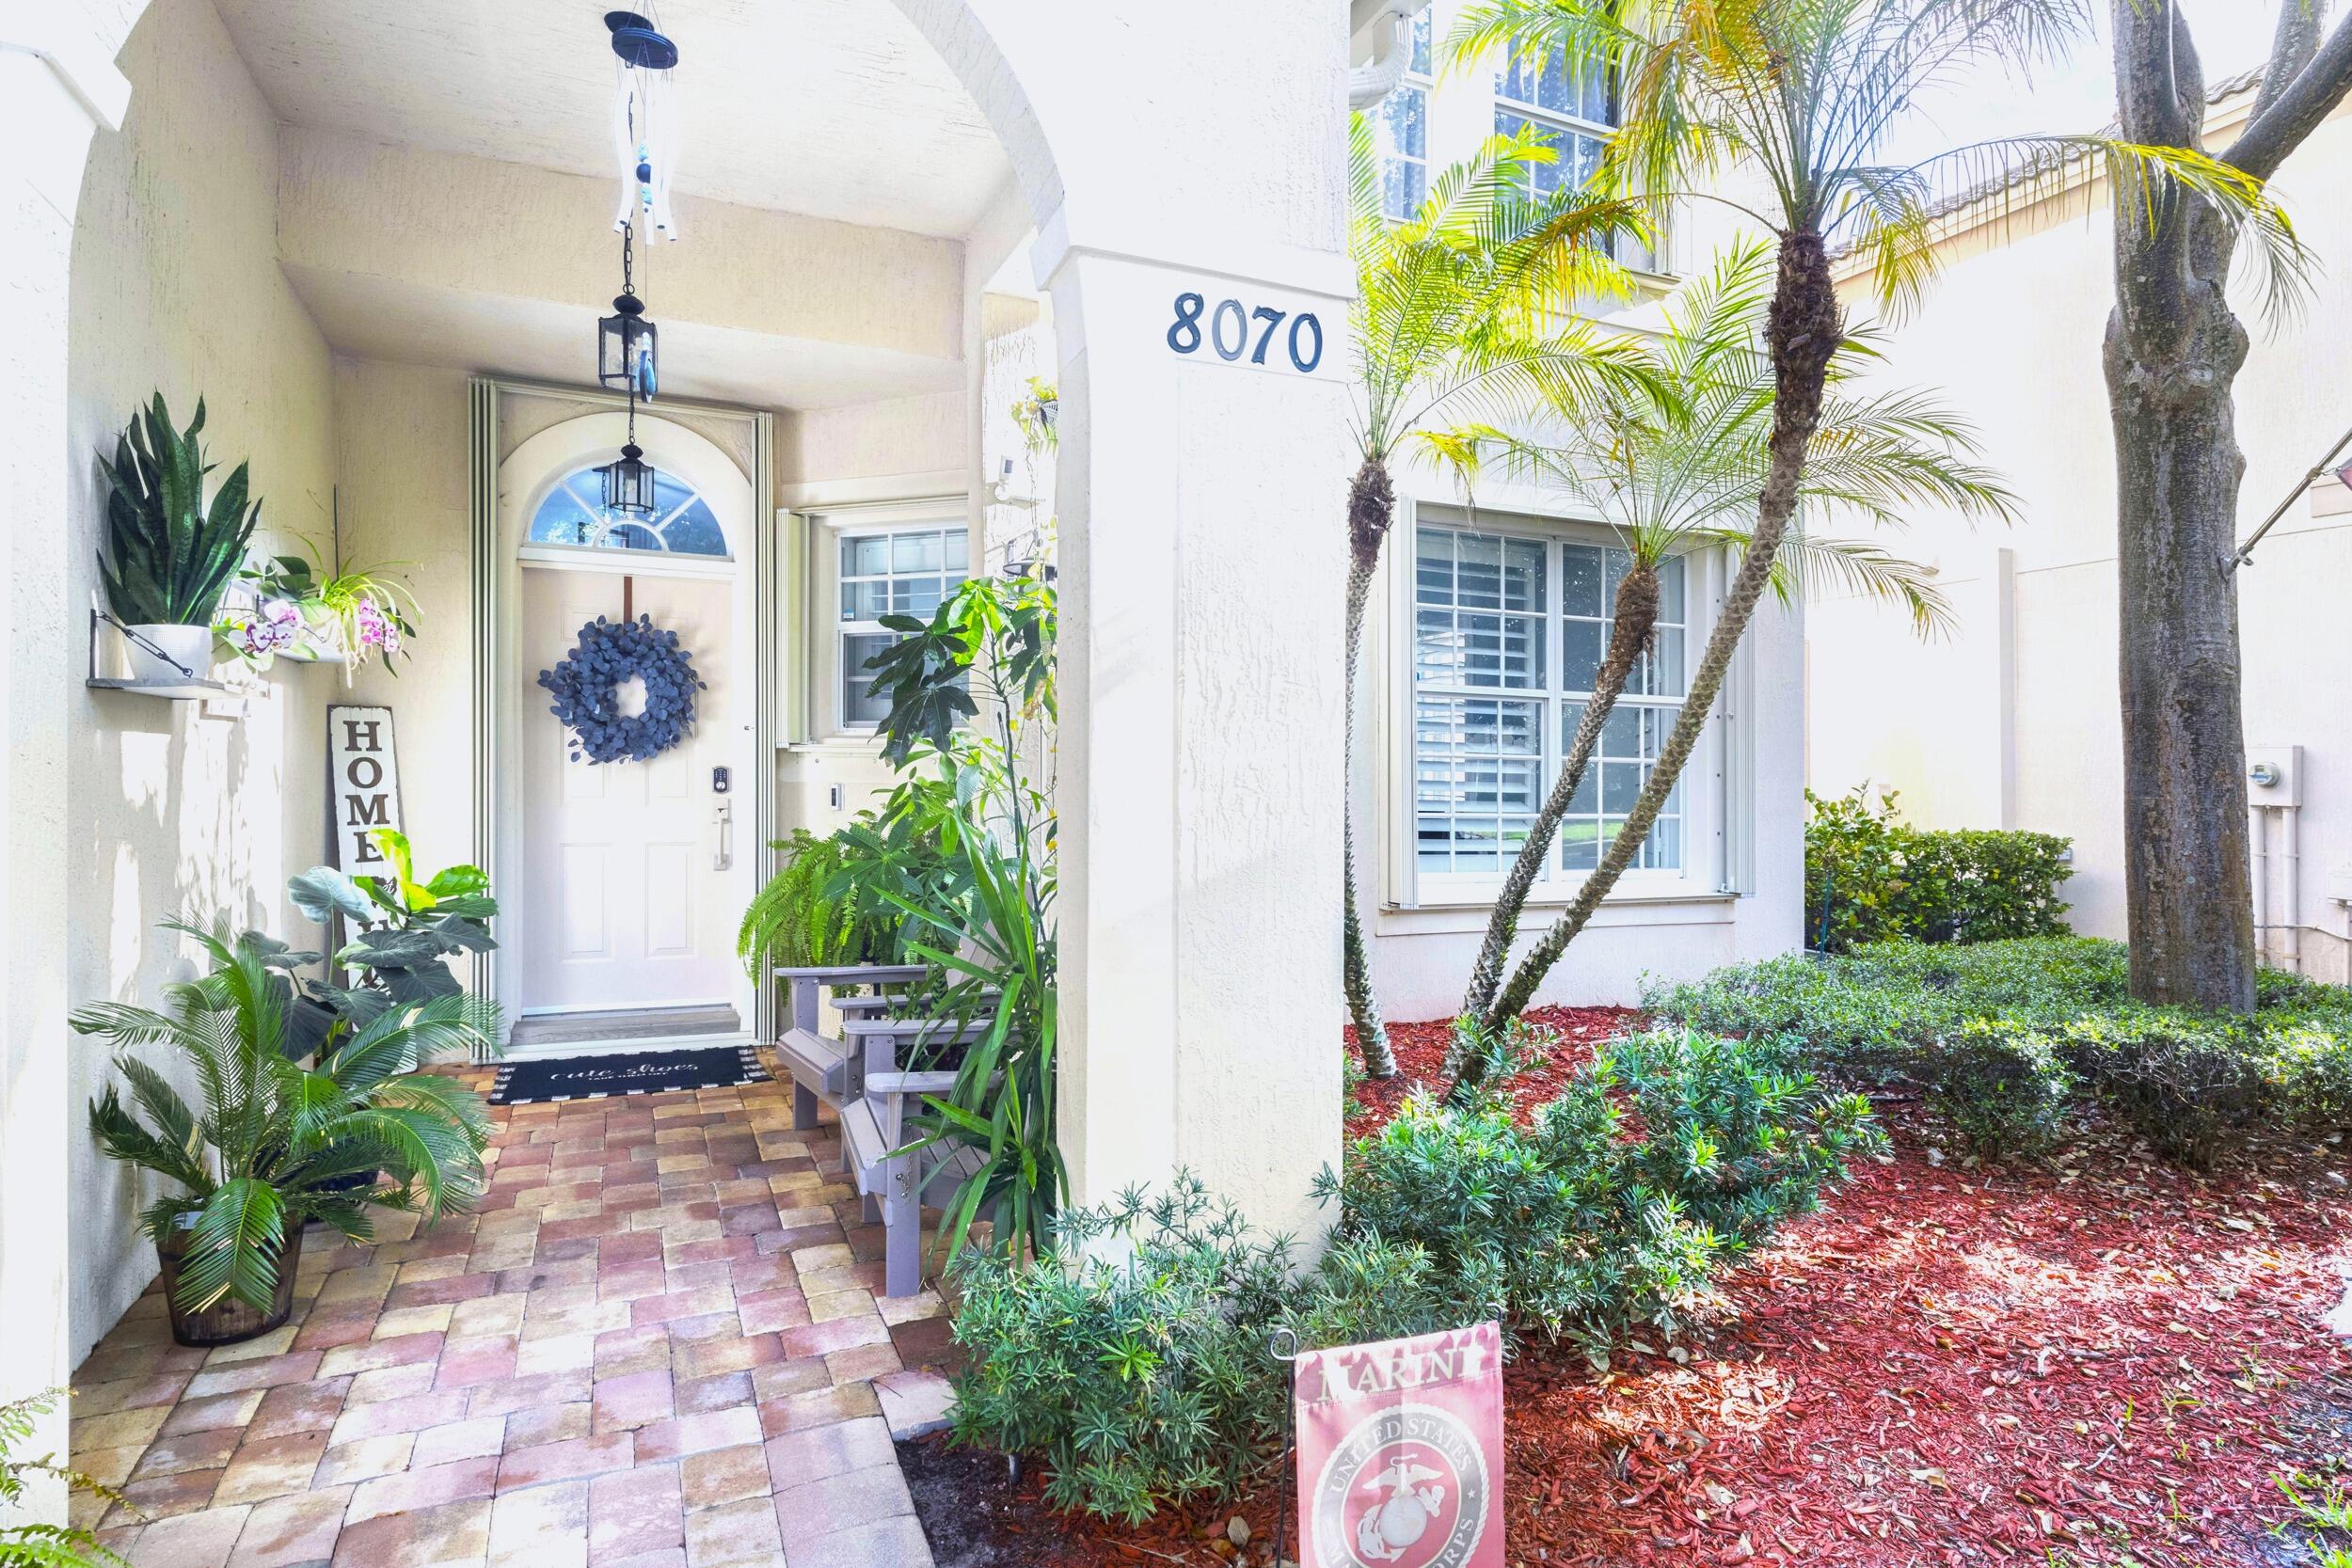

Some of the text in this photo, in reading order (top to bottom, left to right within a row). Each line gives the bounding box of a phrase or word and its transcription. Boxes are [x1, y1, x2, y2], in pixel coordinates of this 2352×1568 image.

[1167, 293, 1323, 372] 8070
[627, 1064, 699, 1075] shoes
[1406, 1418, 1471, 1471] STATES
